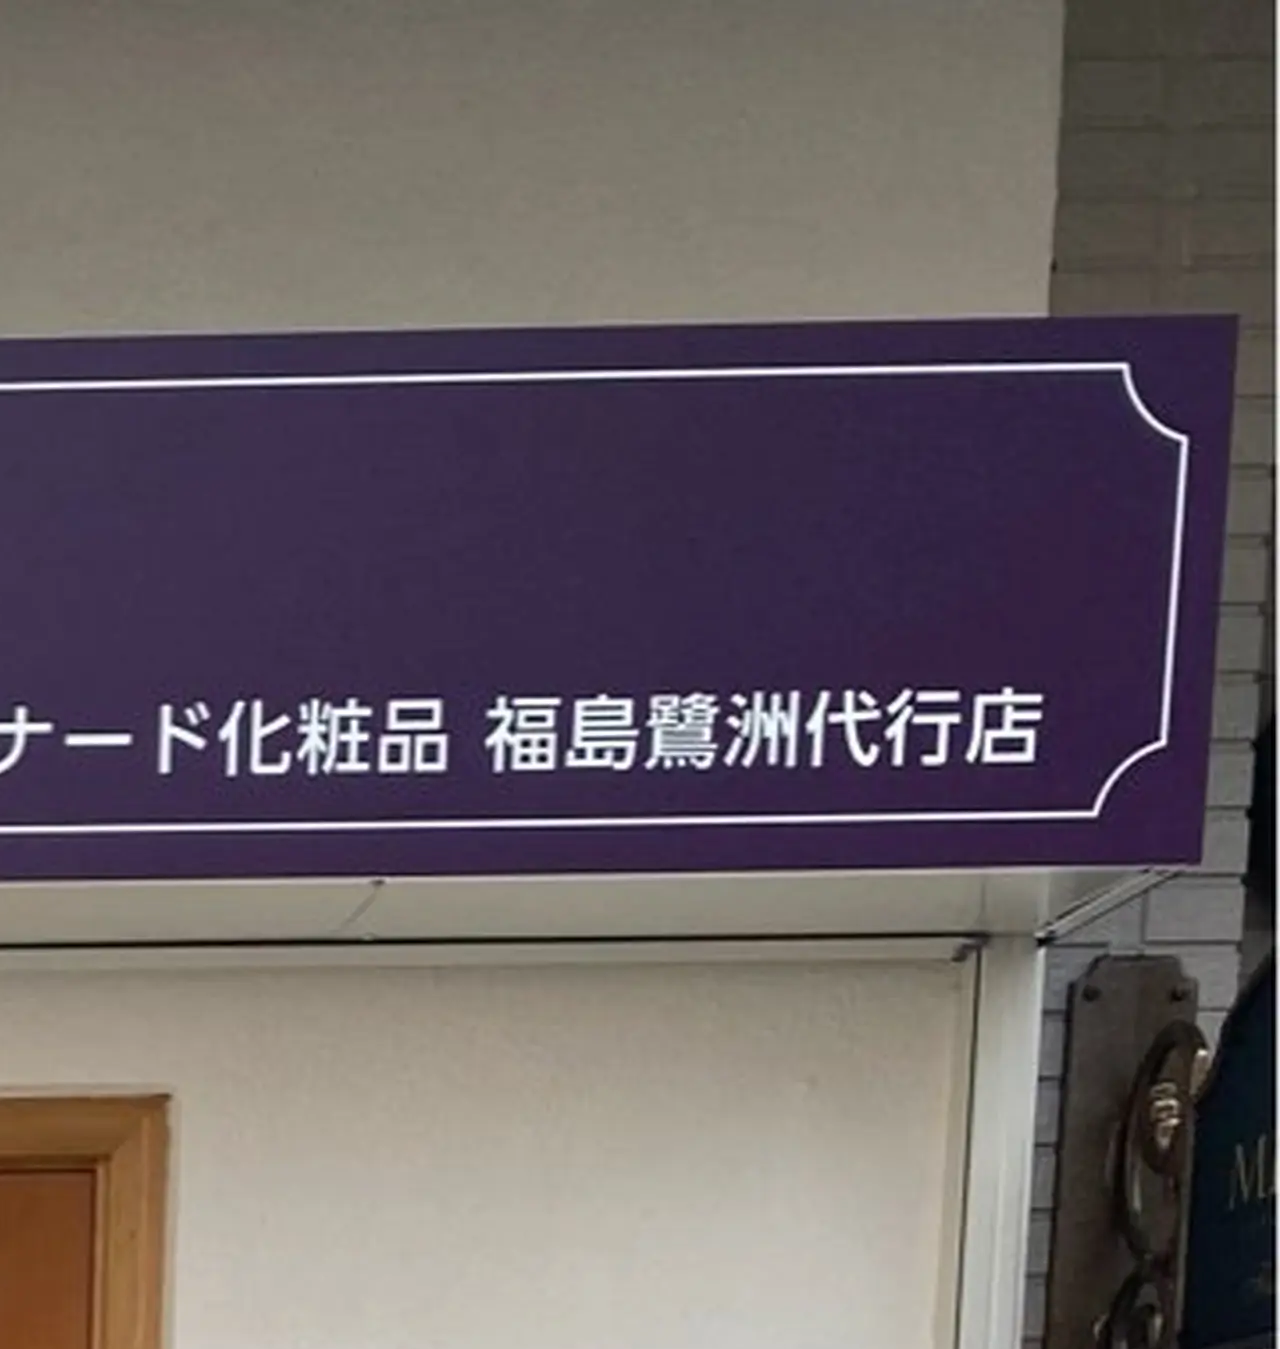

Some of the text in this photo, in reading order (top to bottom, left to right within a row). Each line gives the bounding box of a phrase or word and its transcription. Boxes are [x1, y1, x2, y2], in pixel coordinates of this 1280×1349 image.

[483, 685, 1046, 774] 福島鷺洲代行店
